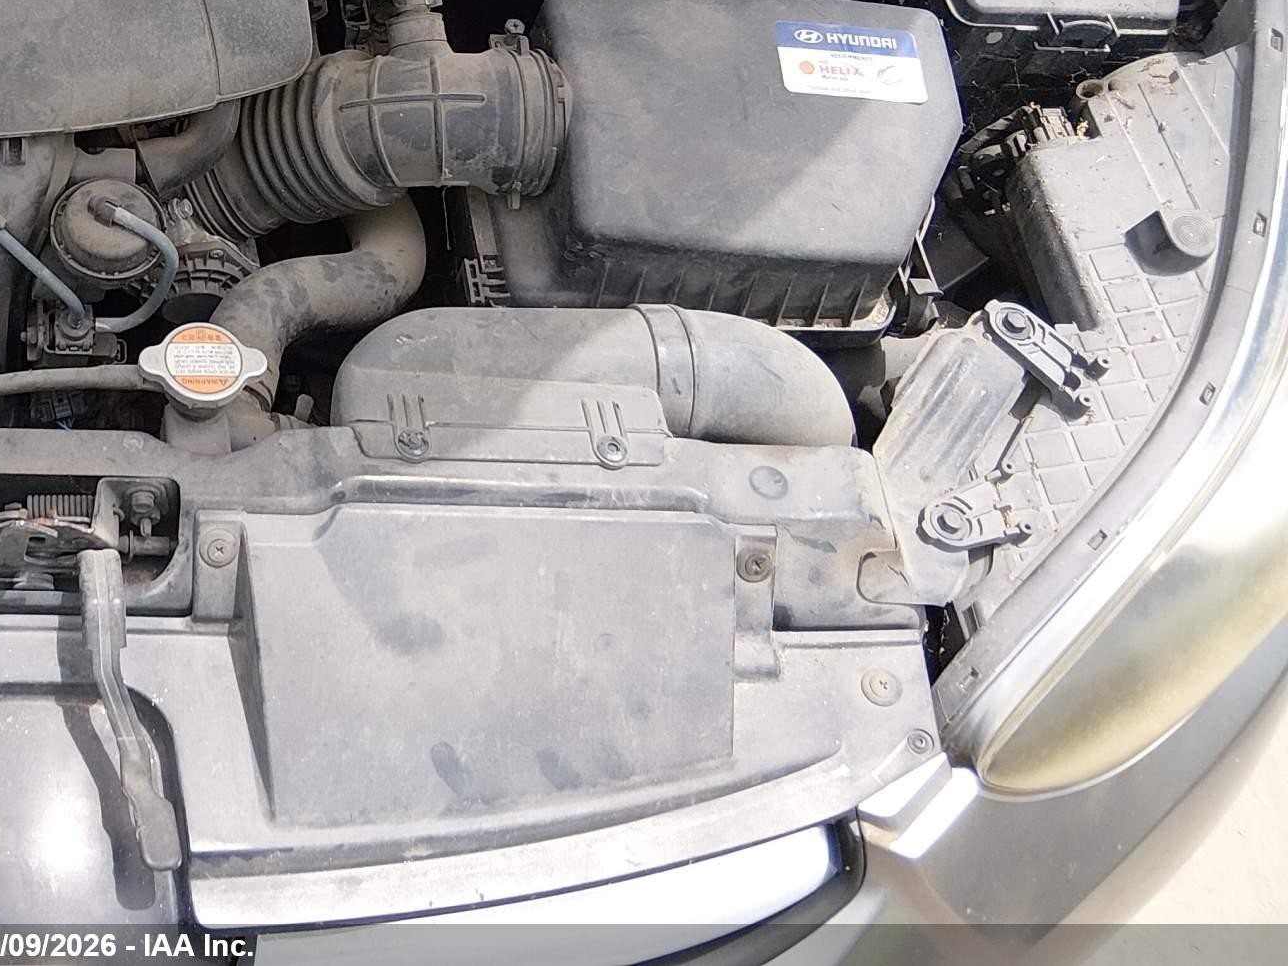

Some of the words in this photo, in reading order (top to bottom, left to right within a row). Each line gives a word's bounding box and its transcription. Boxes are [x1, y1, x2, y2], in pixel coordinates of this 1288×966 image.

[826, 32, 897, 50] HYUNDAI
[818, 64, 860, 77] HELIX
[181, 377, 218, 385] WARNING
